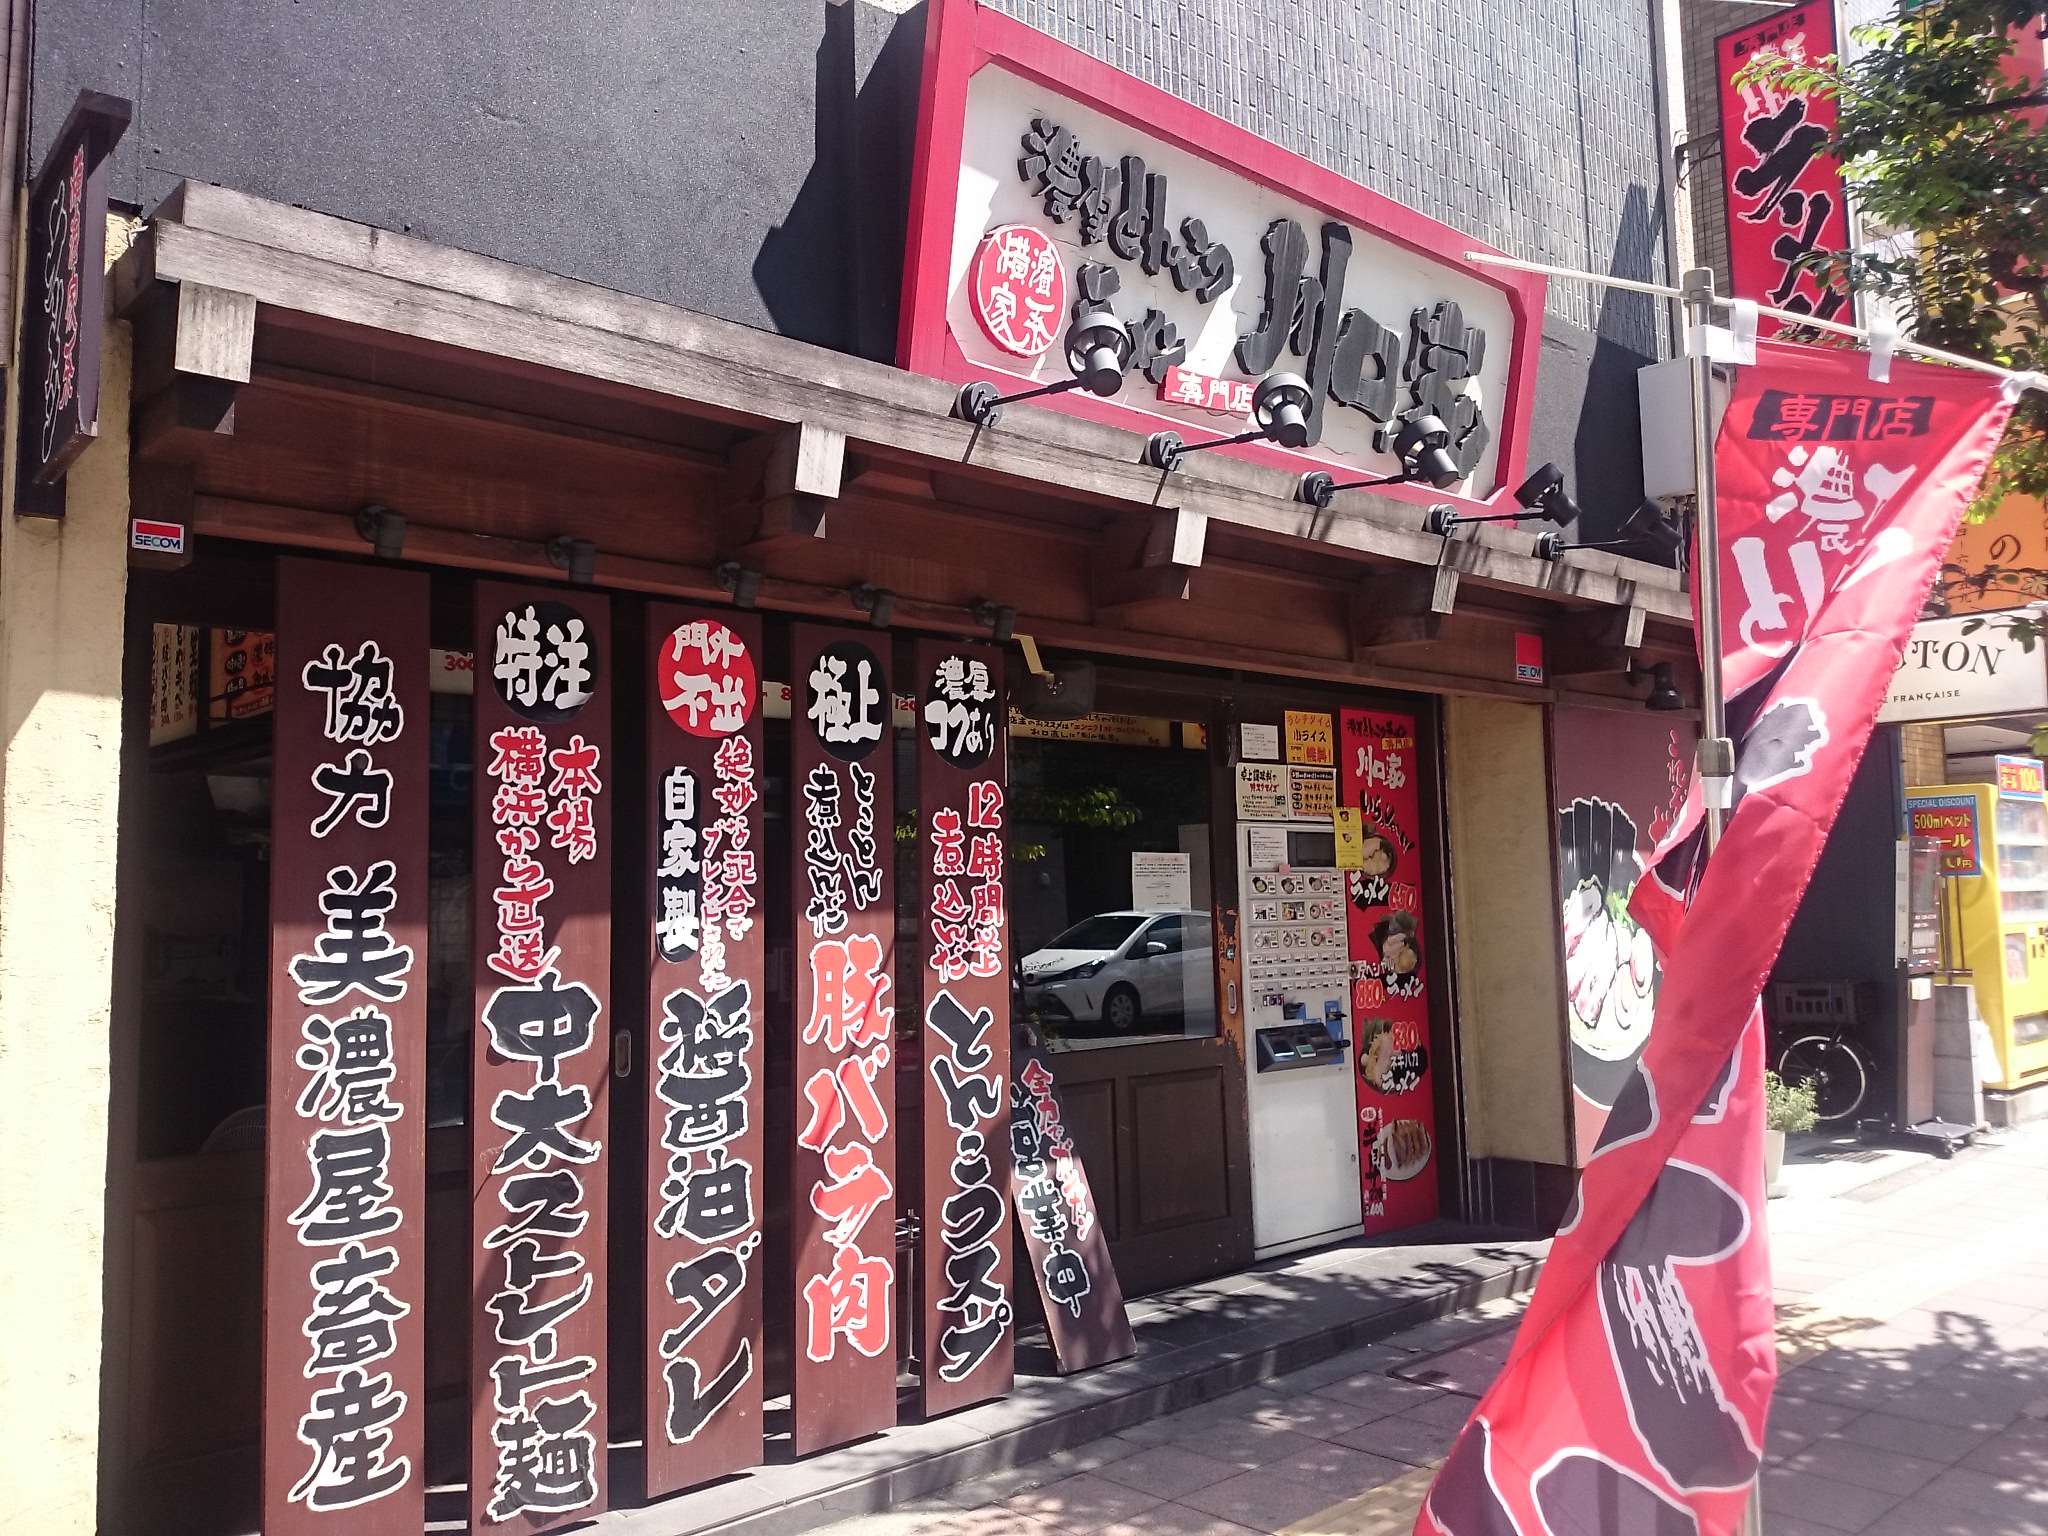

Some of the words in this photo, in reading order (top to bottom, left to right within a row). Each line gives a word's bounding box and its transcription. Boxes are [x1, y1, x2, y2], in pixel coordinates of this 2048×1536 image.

[1174, 371, 1254, 412] 専門店
[1769, 394, 1921, 440] 専門店
[134, 534, 183, 550] SECOM
[1989, 534, 2022, 564] の
[493, 606, 594, 709] 特注
[662, 671, 747, 732] 不出
[672, 622, 746, 669] 門外
[807, 655, 883, 744] 極上
[934, 655, 996, 700] 濃厚
[1893, 690, 1961, 703] FRANÇAISE
[302, 640, 404, 838] 協力
[924, 699, 995, 759] コクあり
[1293, 729, 1327, 742] 小ライス
[1355, 745, 1406, 789] 川口家
[486, 726, 562, 983] 横浜から直送
[547, 735, 602, 864] 本場
[656, 766, 700, 952] 自家製
[713, 735, 757, 941] 絶妙な配合で
[803, 763, 848, 938] 煮込んだ
[842, 762, 883, 910] とことん
[1908, 798, 1937, 809] SPECIAL
[1939, 796, 1975, 807] DISCOUNT
[699, 826, 732, 993] ブレンドされた
[930, 807, 969, 984] 煮込んだ
[967, 780, 1004, 978] 12時間以上
[287, 860, 414, 1513] 美濃屋畜産
[654, 978, 761, 1445] 醤油ダレ
[798, 932, 895, 1363] 豚バラ肉
[924, 989, 1013, 1384] とんこつスープ
[1010, 1082, 1091, 1319] 営業中
